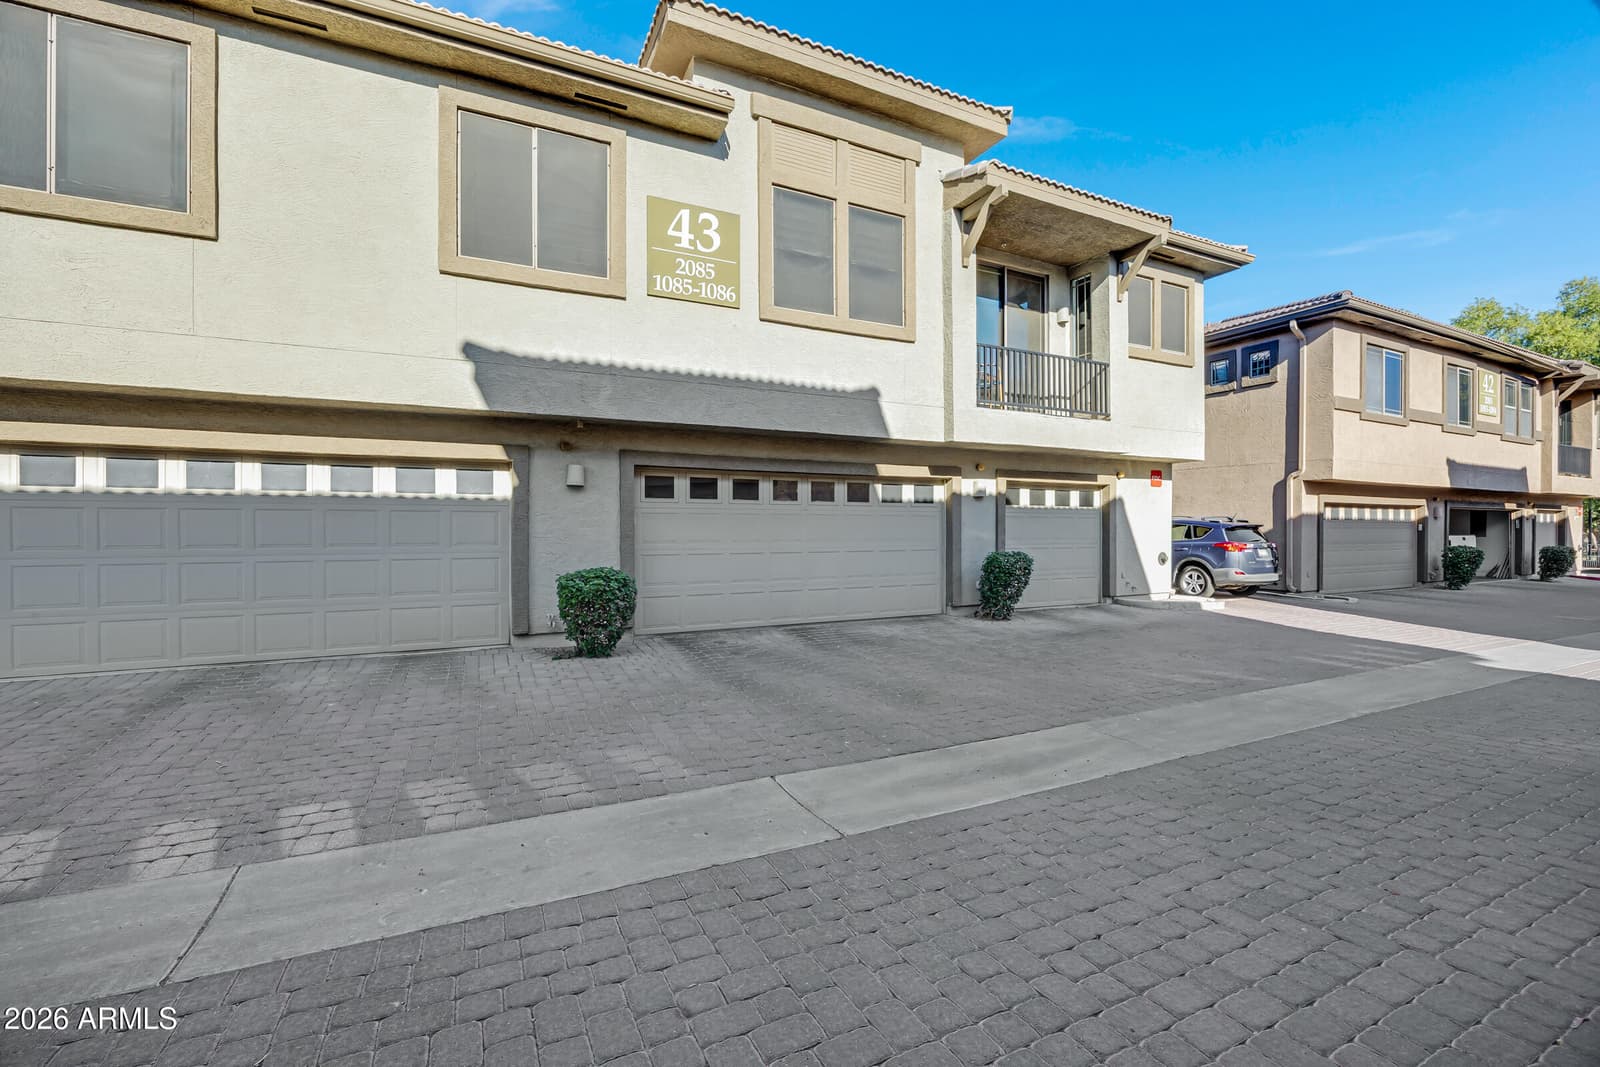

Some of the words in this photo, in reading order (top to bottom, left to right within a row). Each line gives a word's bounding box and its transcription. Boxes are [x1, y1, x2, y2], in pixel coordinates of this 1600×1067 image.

[667, 208, 721, 253] 43
[675, 258, 716, 280] 2085
[652, 274, 737, 303] 1085-1086
[1482, 374, 1495, 394] 42
